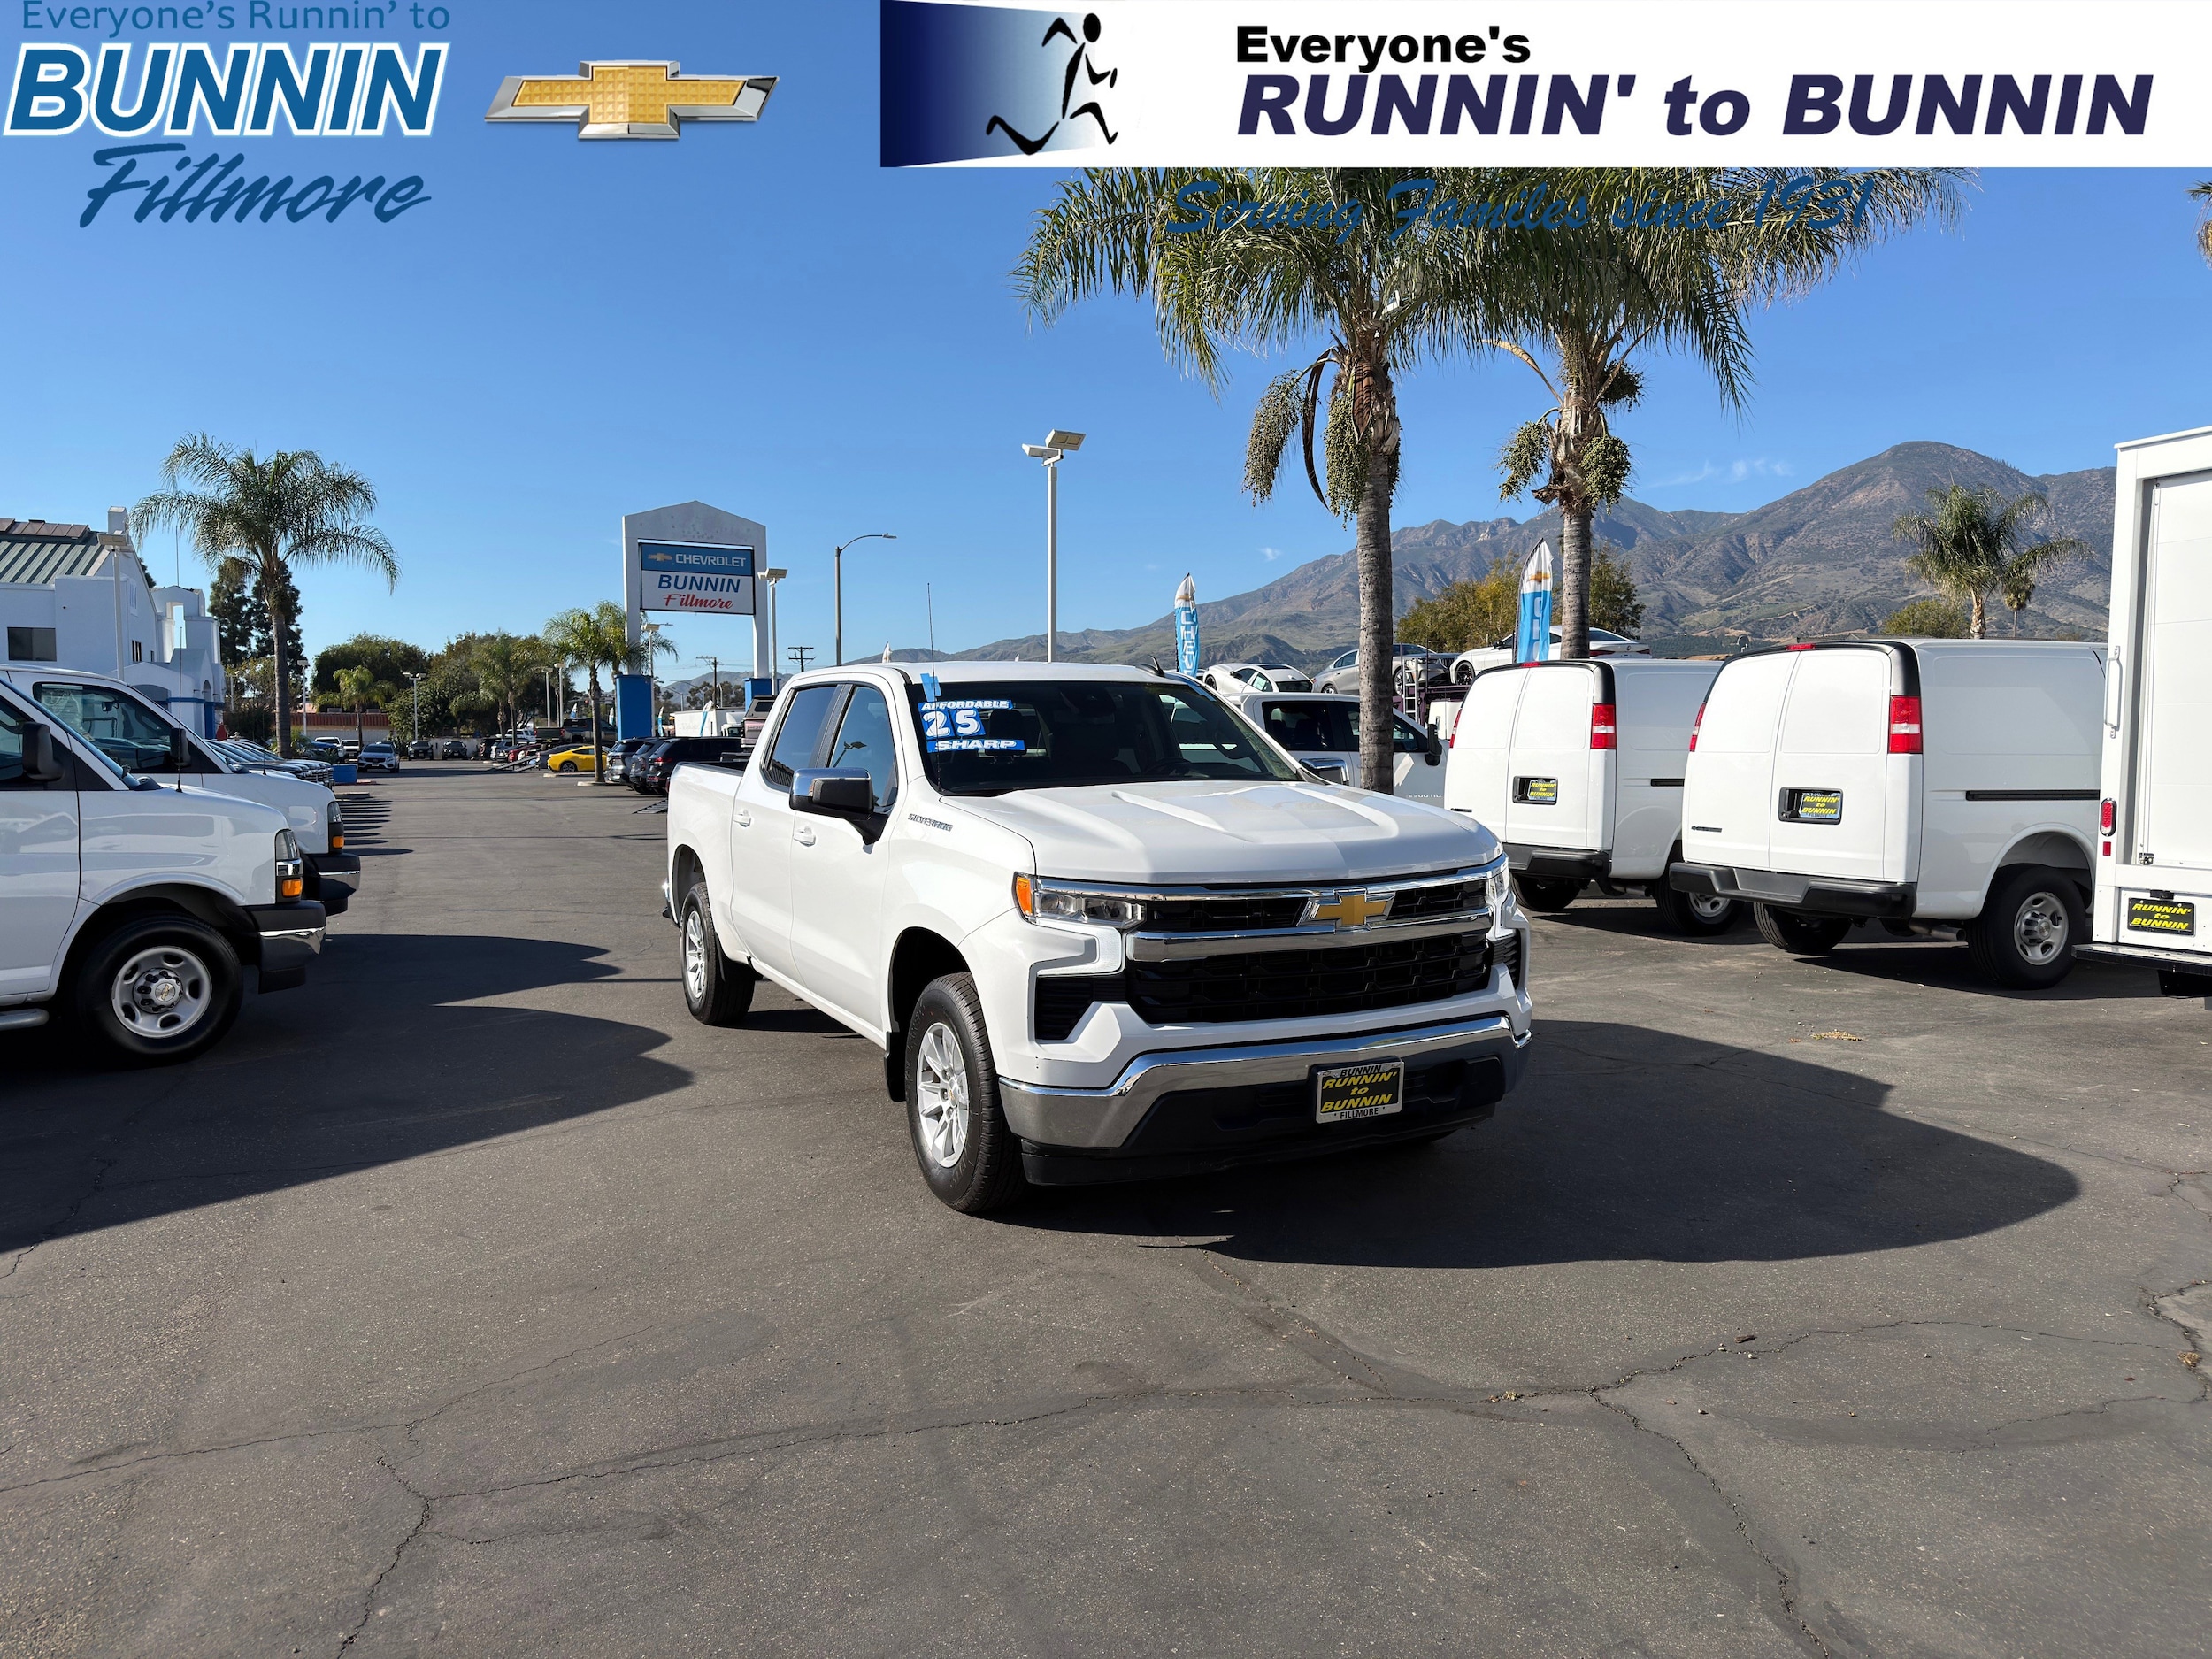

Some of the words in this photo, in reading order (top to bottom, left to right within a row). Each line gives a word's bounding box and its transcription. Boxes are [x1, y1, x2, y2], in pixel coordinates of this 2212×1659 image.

[675, 553, 746, 567] CHEVROLET
[657, 574, 741, 593] BUNNIN
[663, 594, 733, 610] Fillmore
[921, 700, 1010, 710] AFFORDABLE
[923, 710, 981, 737] 25
[934, 740, 1017, 751] SHARP
[2131, 902, 2193, 915] RUNNIN'
[2131, 918, 2189, 930] BUNNIN
[1340, 1064, 1382, 1077] BUNNIN
[1322, 1071, 1398, 1090] RUNNIN'
[1349, 1087, 1370, 1096] to
[1320, 1093, 1393, 1112] BUNNIN
[1340, 1107, 1379, 1119] FILLMORE
